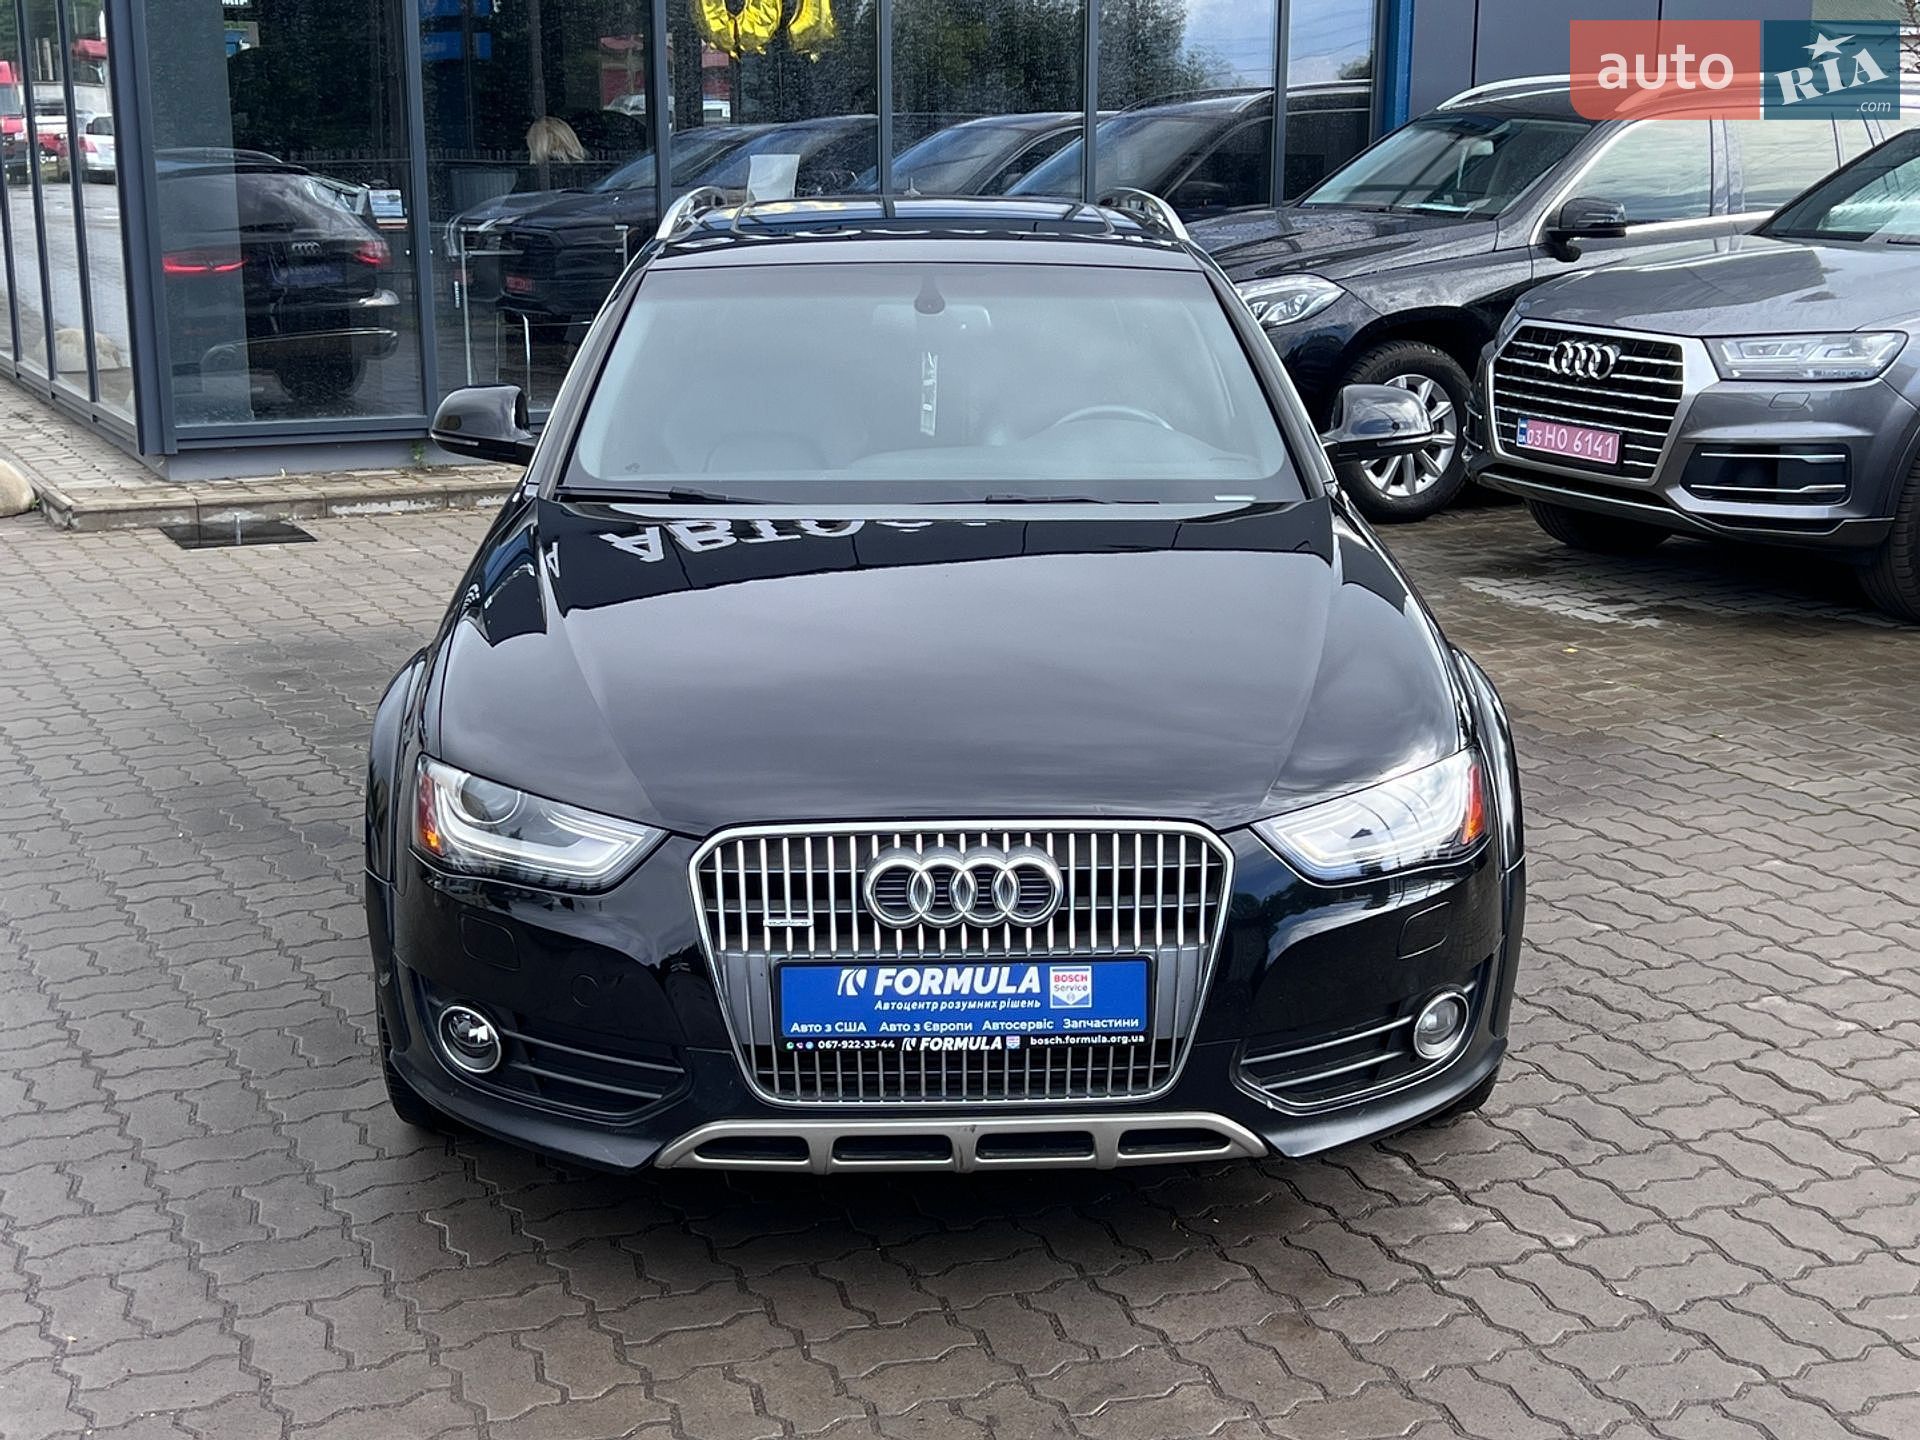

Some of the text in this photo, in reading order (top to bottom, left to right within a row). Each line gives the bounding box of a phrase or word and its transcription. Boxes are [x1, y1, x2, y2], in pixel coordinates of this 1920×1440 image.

[1544, 425, 1568, 449] HO
[1573, 431, 1614, 459] 6141
[874, 966, 1041, 996] FORMULA
[1053, 974, 1088, 983] BOSCH
[1053, 984, 1088, 992] Service
[874, 998, 1041, 1012] Автоцентр розумних рішень
[790, 1021, 867, 1033] Авто з США
[879, 1020, 973, 1034] Авто з Європи
[982, 1019, 1055, 1032] Автосервіс
[1063, 1018, 1139, 1029] Запчастини
[817, 1040, 896, 1049] 067-922-33-44
[919, 1037, 1003, 1051] FORMULA
[1030, 1034, 1145, 1046] bosch.formula.org.ua
